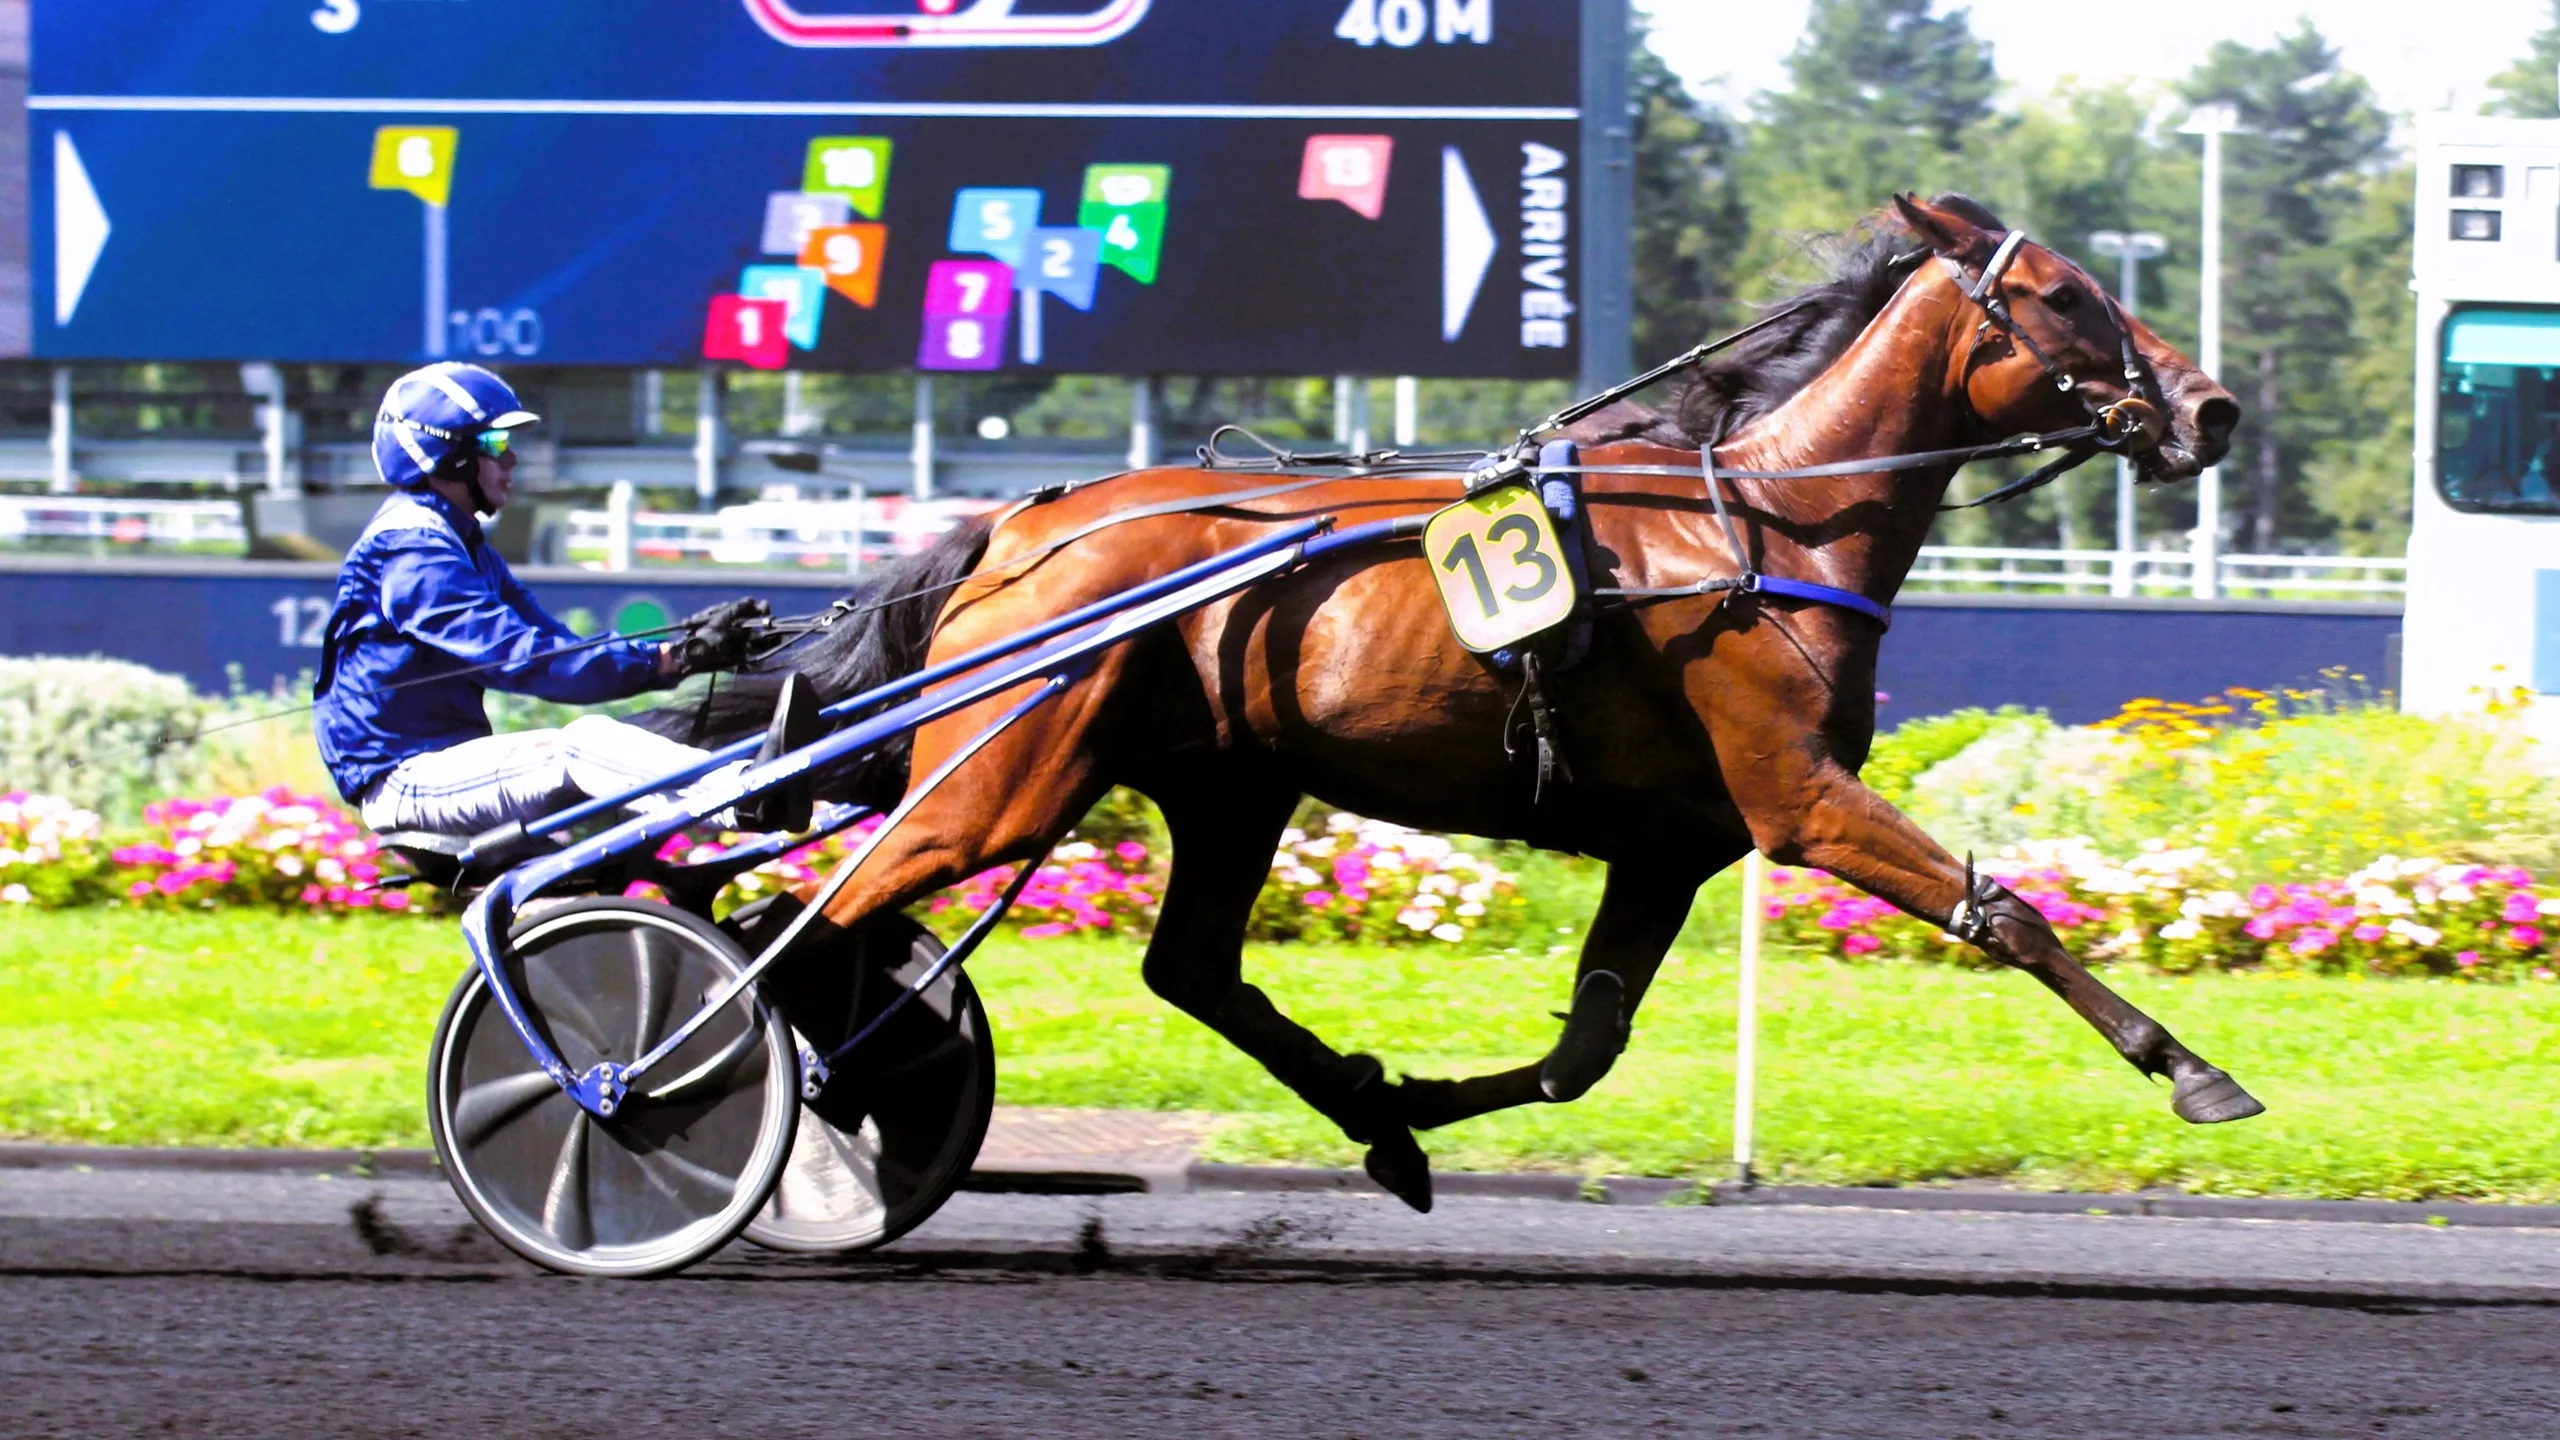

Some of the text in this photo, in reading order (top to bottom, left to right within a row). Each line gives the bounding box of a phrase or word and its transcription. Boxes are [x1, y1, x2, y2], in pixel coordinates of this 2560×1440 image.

[1334, 0, 1494, 46] 40 M
[397, 135, 435, 178] 6
[1320, 147, 1374, 186] 13
[980, 200, 1014, 241] 5
[1104, 213, 1140, 251] 4
[824, 234, 861, 275] 9
[1041, 238, 1075, 279] 2
[1520, 141, 1576, 348] ARRIVÉE
[955, 271, 988, 313] 7
[449, 308, 542, 356] 100
[736, 307, 762, 346] 1
[946, 319, 984, 359] 8
[1440, 513, 1559, 620] 13
